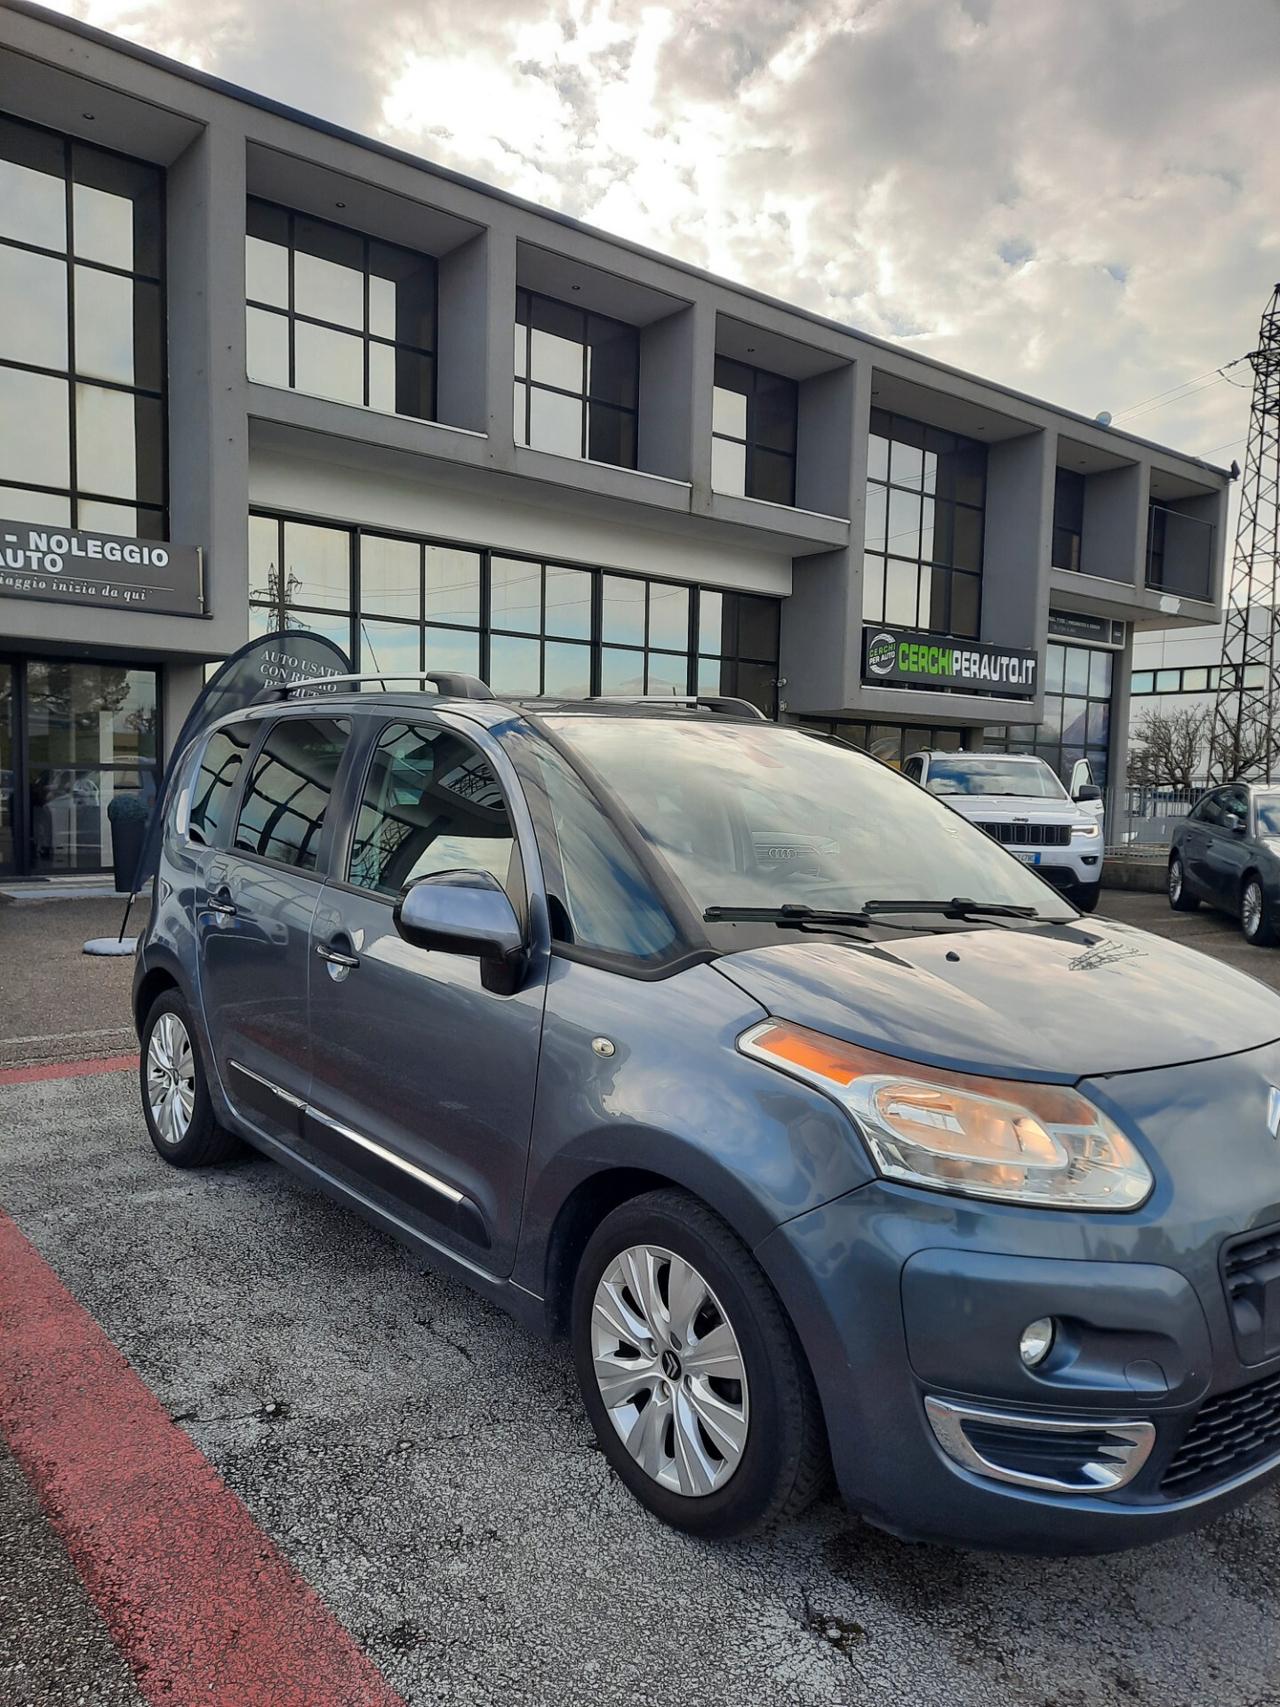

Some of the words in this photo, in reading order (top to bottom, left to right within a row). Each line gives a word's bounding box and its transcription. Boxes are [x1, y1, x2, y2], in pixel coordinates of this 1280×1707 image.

[29, 531, 169, 567] NOLEGGIO
[52, 579, 96, 595] inizia
[102, 585, 118, 598] da
[124, 590, 147, 602] qui
[261, 650, 298, 667] AUTO
[869, 643, 896, 657] CERCHI
[869, 655, 880, 665] PER
[881, 651, 896, 662] AUTO
[260, 663, 288, 679] CON
[898, 642, 1036, 685] CERCHIPERAUTO.IT
